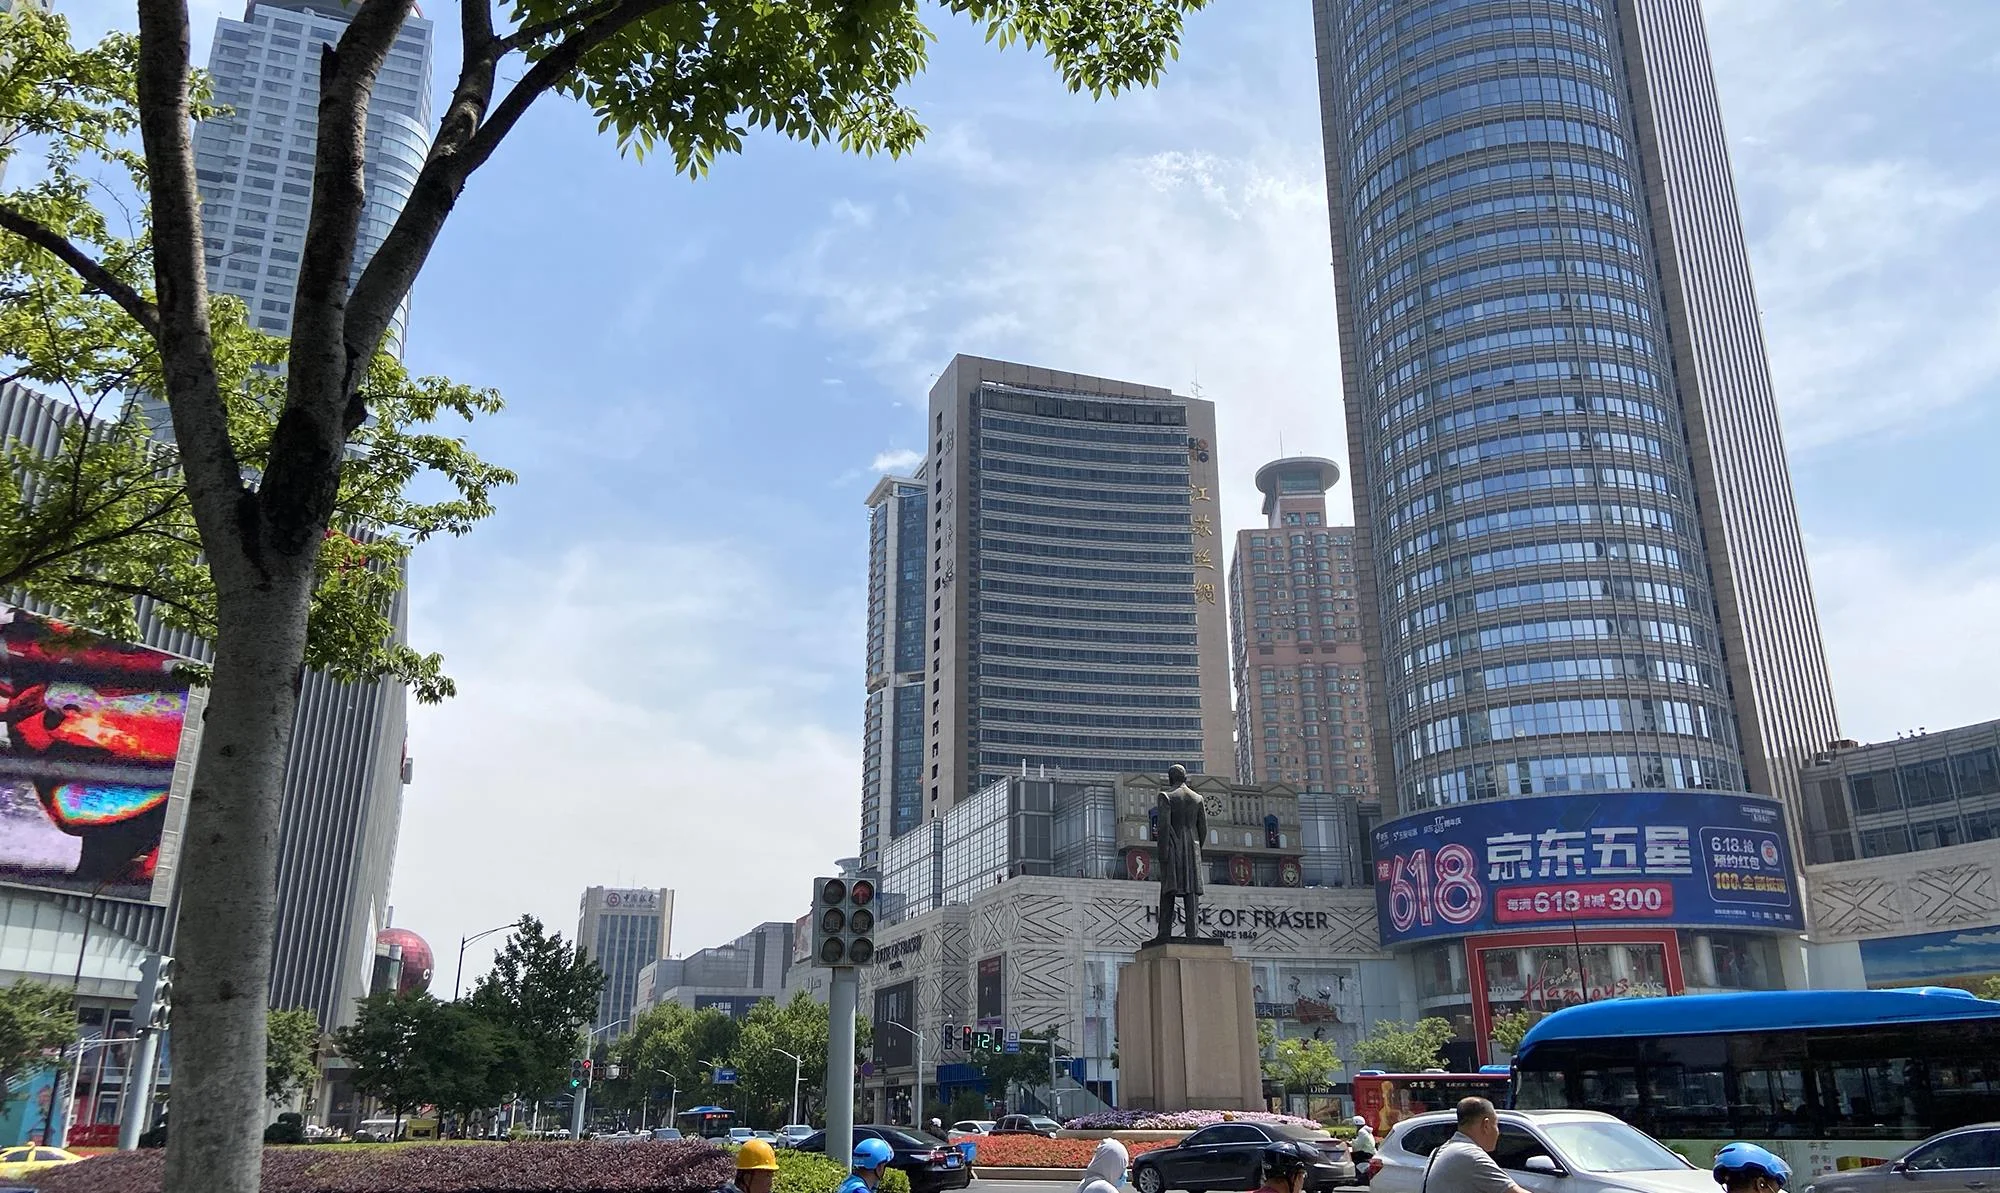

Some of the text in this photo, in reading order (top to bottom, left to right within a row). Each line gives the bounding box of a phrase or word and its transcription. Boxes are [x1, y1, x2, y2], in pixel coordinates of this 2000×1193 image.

[1190, 483, 1216, 605] 江苏丝绸
[1486, 826, 1692, 880] 京东五星
[1711, 836, 1755, 853] 6.18抢
[1713, 854, 1760, 870] 预约红包
[1389, 843, 1482, 933] 618
[1219, 908, 1246, 928] OF
[1253, 910, 1329, 930] FRASER
[1212, 929, 1237, 940] SINCE
[977, 1033, 990, 1049] 12
